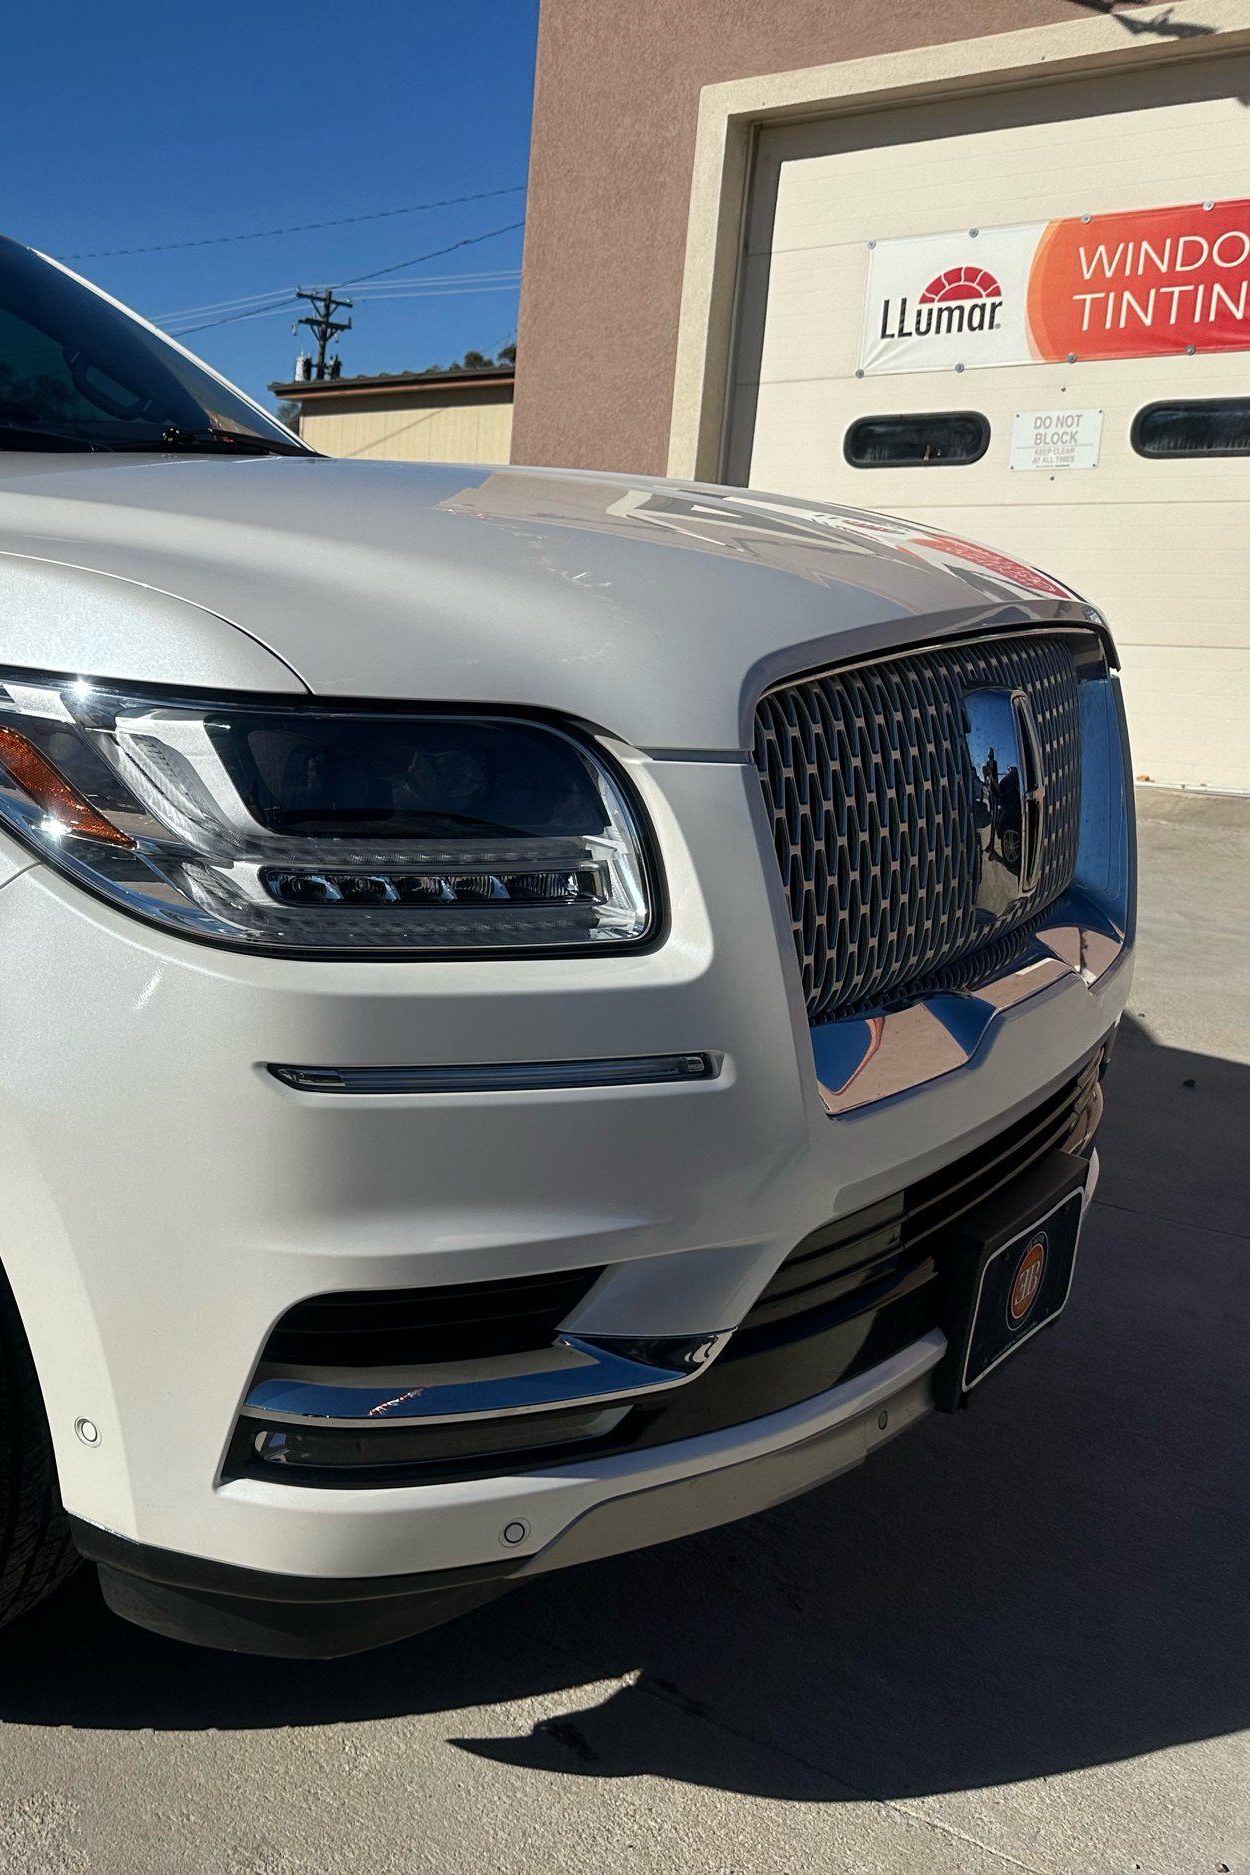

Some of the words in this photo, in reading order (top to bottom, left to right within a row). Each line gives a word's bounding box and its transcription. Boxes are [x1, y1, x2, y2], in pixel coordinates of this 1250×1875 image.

[880, 297, 1002, 339] LLumar
[1033, 416, 1052, 430] DO
[1055, 414, 1083, 428] NOT
[1034, 430, 1079, 446] BLOCK
[1034, 448, 1052, 456] KEEP
[1053, 447, 1075, 455] CLEAR
